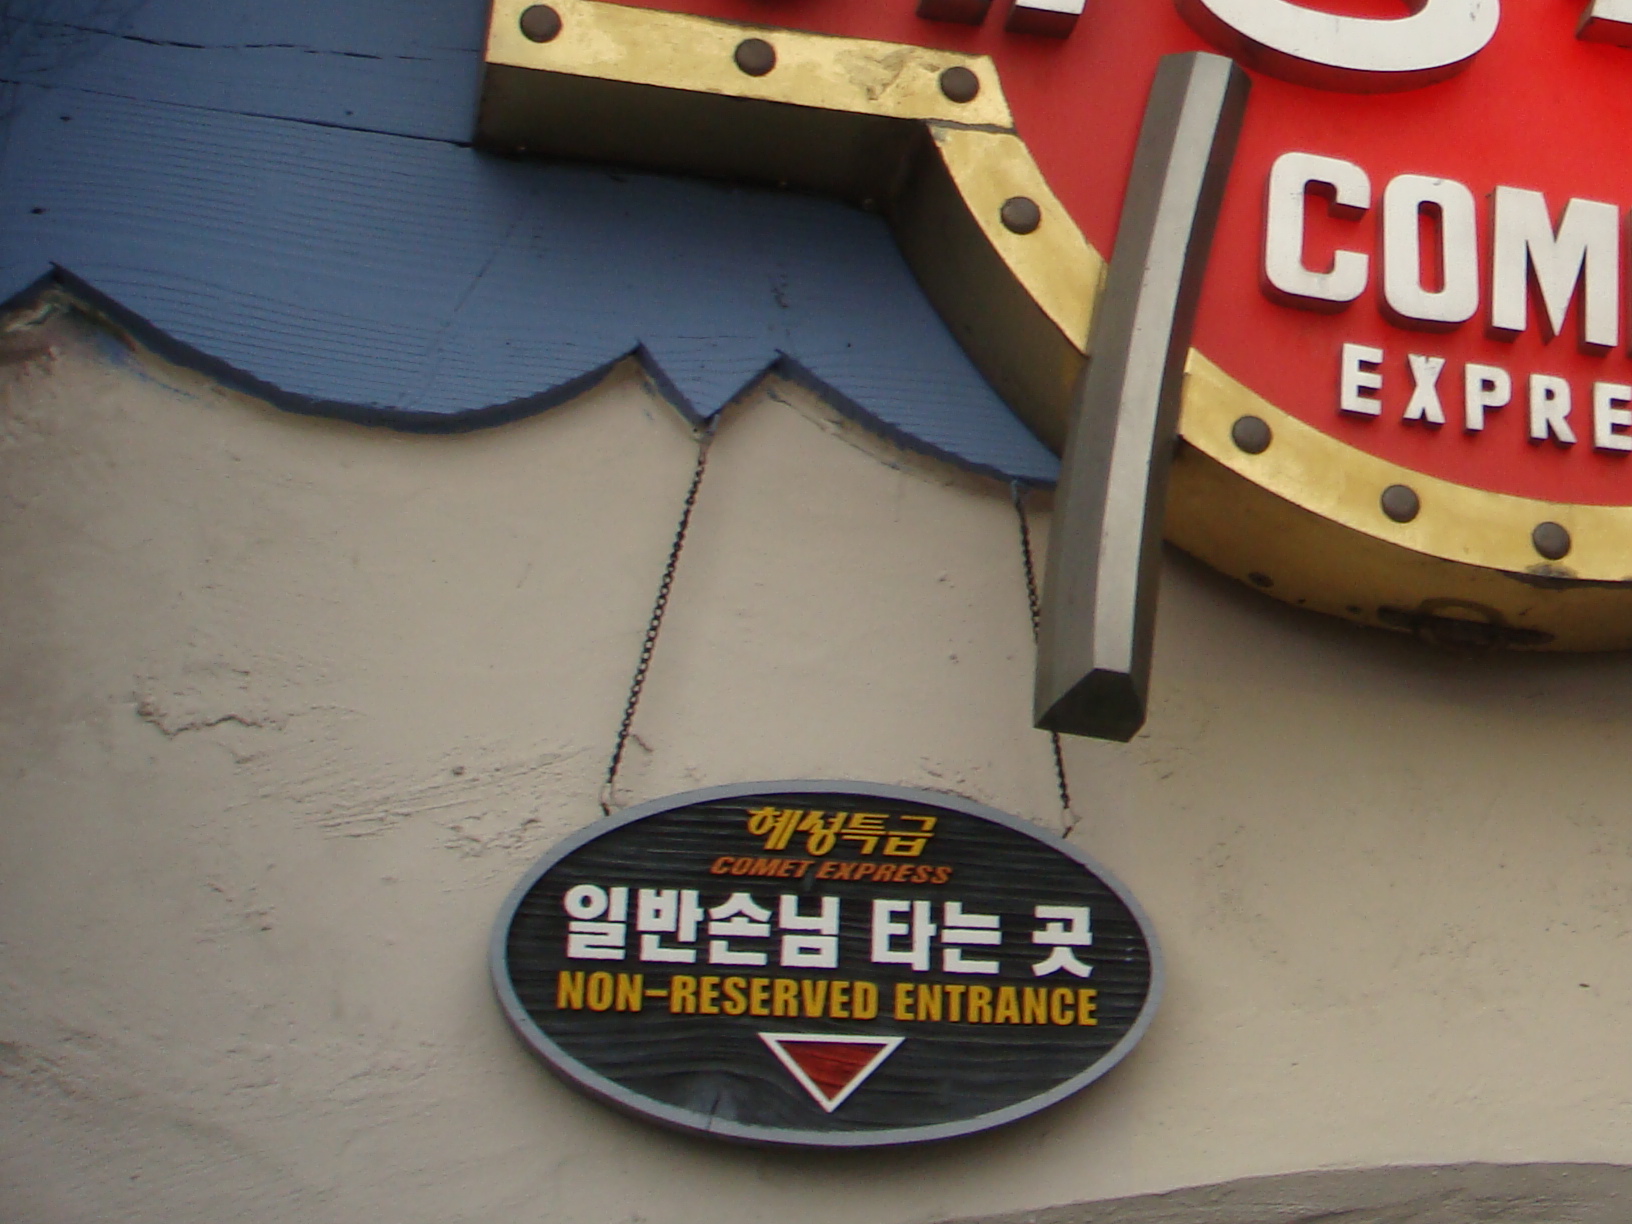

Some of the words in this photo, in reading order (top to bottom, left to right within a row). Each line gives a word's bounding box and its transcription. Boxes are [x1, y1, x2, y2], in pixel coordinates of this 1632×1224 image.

[746, 806, 938, 857] 혜성특급
[709, 855, 810, 879] COMET
[816, 859, 953, 885] EXPRESS
[563, 883, 839, 969] 일반손님
[870, 898, 1002, 975] 타는
[1031, 905, 1093, 978] 곳
[556, 969, 878, 1021] NON-RESERVED
[895, 982, 1098, 1027] ENTRANCE
